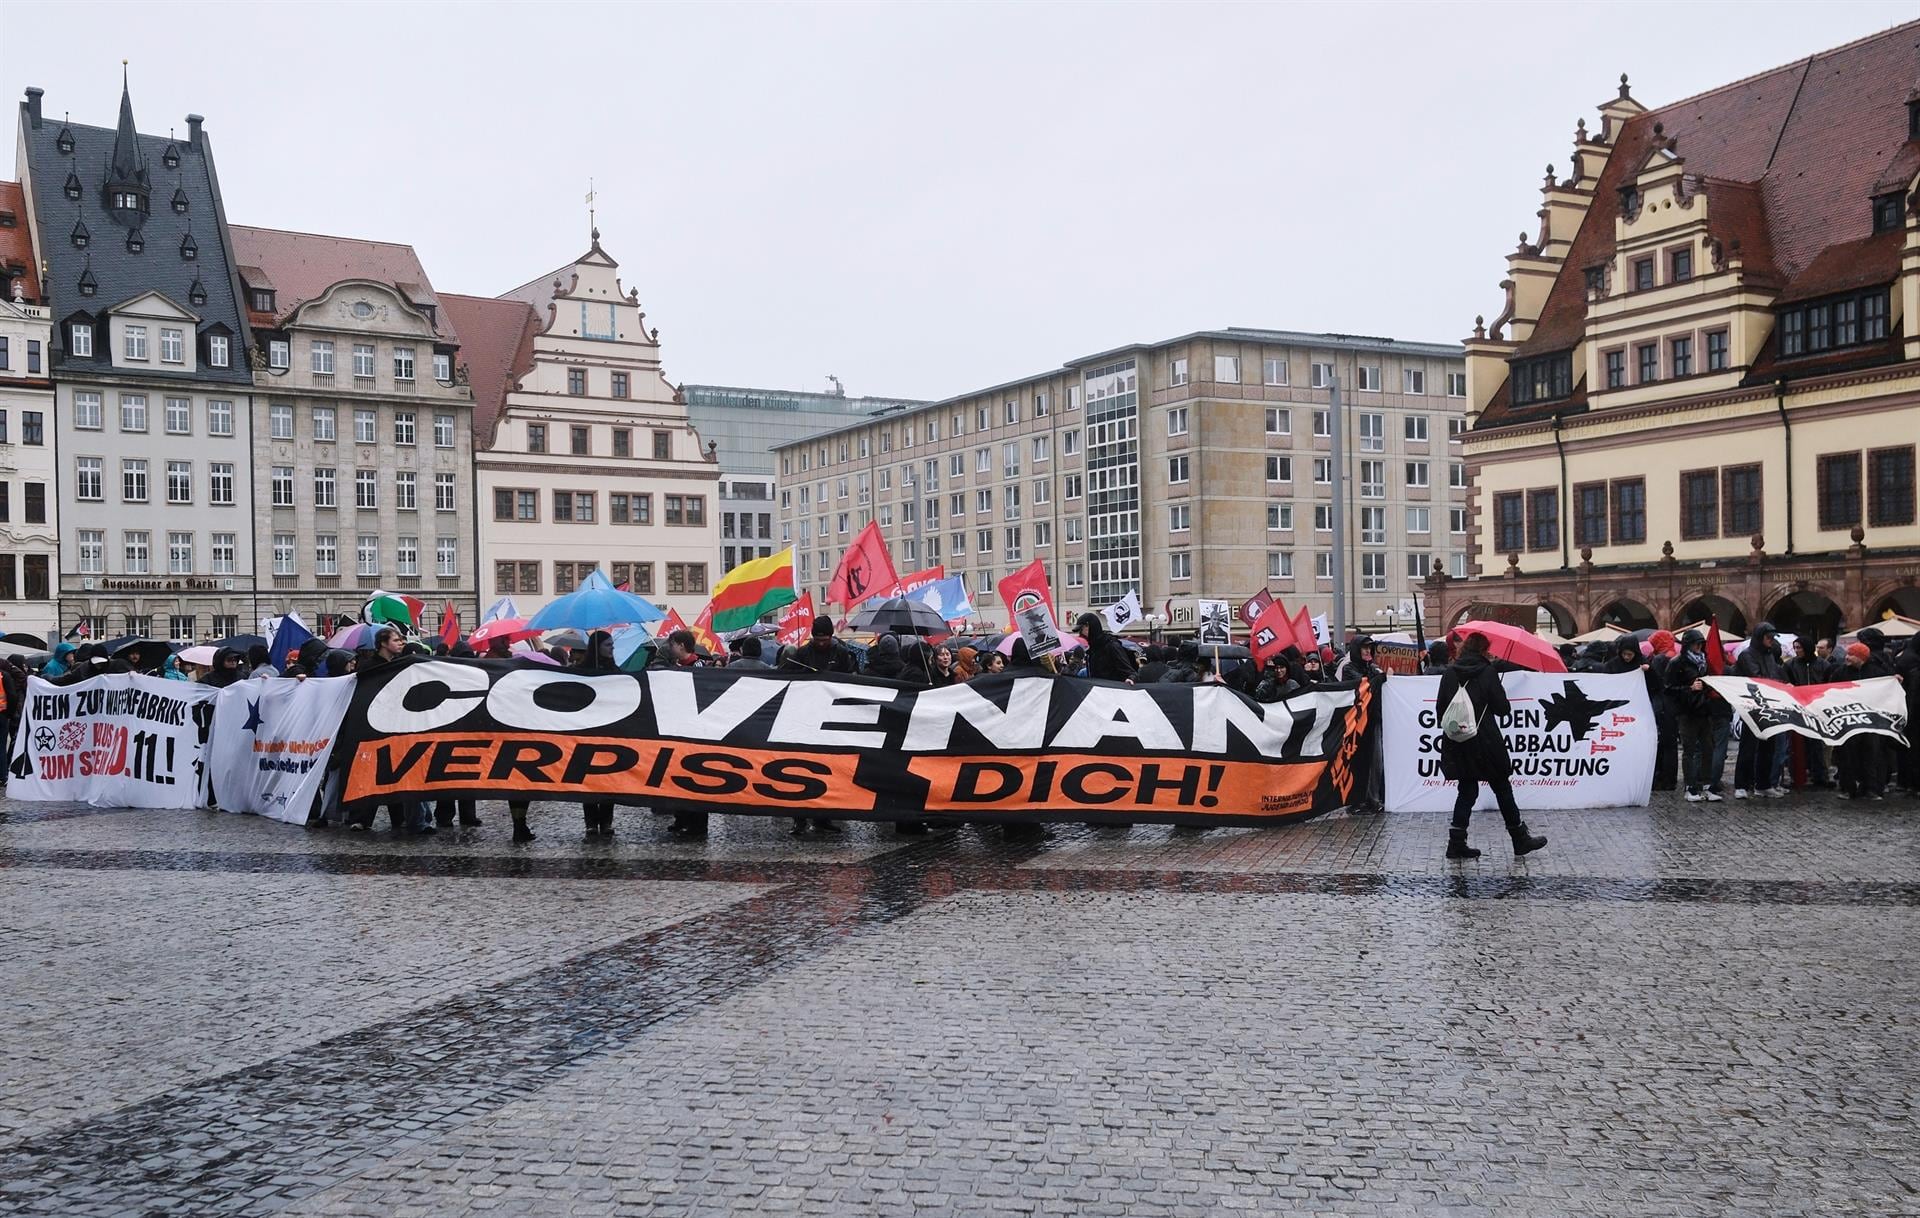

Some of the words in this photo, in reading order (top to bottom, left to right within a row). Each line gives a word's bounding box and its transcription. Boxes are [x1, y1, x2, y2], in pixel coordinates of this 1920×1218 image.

[101, 578, 161, 591] Augustiner
[166, 582, 181, 590] am
[186, 578, 218, 590] Markt
[1686, 575, 1729, 586] BRASSERIE
[1773, 570, 1833, 582] RESTAURANT
[76, 689, 105, 717] ZUR
[367, 661, 1356, 758] COVENANT
[1418, 735, 1571, 754] SOABBAU
[39, 754, 74, 780] ZUM
[375, 739, 833, 801] VERPISS
[950, 761, 1226, 808] DICH!
[1417, 758, 1447, 778] UN
[1512, 753, 1610, 777] RÜSTUNG
